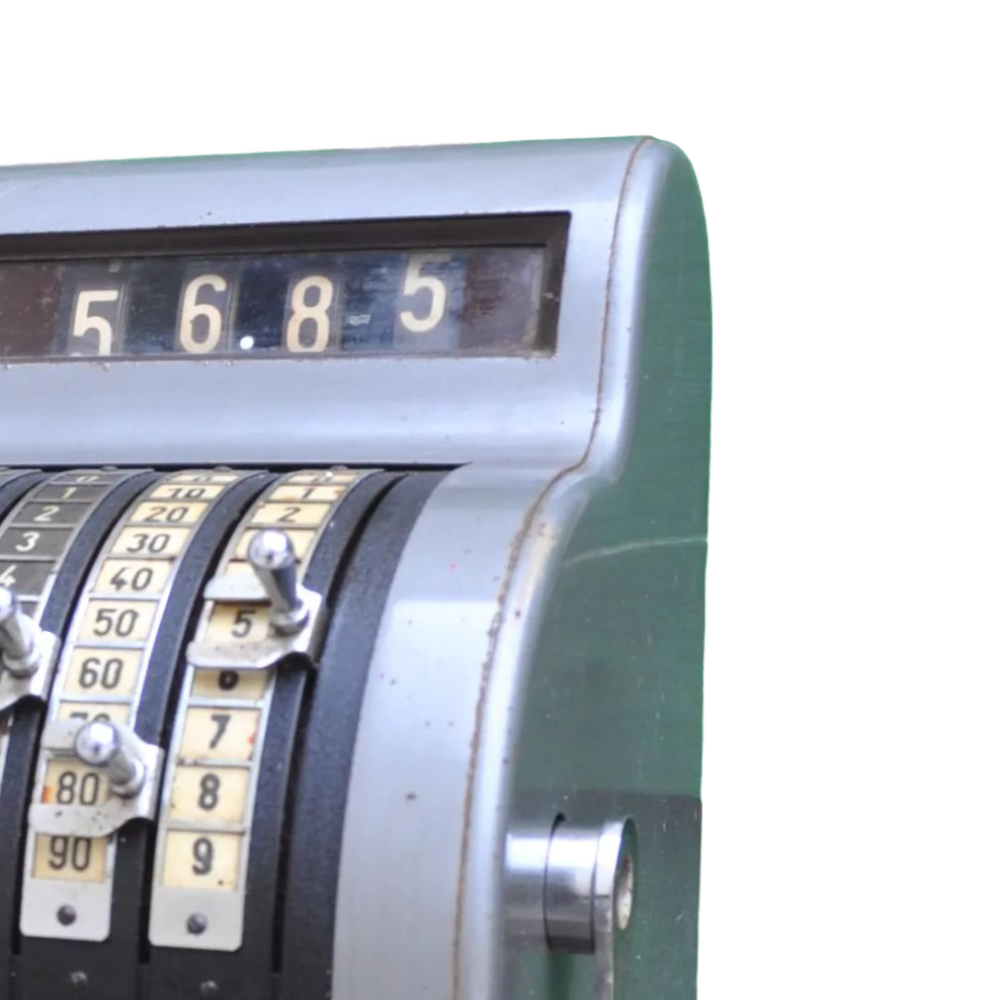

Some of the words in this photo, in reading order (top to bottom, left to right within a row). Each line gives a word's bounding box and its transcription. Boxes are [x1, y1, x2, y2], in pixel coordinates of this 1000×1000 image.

[62, 486, 78, 499] 1
[301, 487, 316, 499] 1
[34, 505, 60, 522] 2
[143, 505, 190, 523] 20
[277, 506, 302, 523] 2
[15, 531, 41, 552] 3
[126, 533, 172, 554] 30
[109, 567, 155, 592] 40
[92, 608, 141, 638] 50
[231, 609, 258, 639] 5
[78, 657, 125, 691] 60
[209, 714, 232, 750] 7
[56, 771, 100, 806] 80
[197, 773, 221, 812] 8
[48, 835, 93, 872] 90
[191, 837, 215, 877] 9
